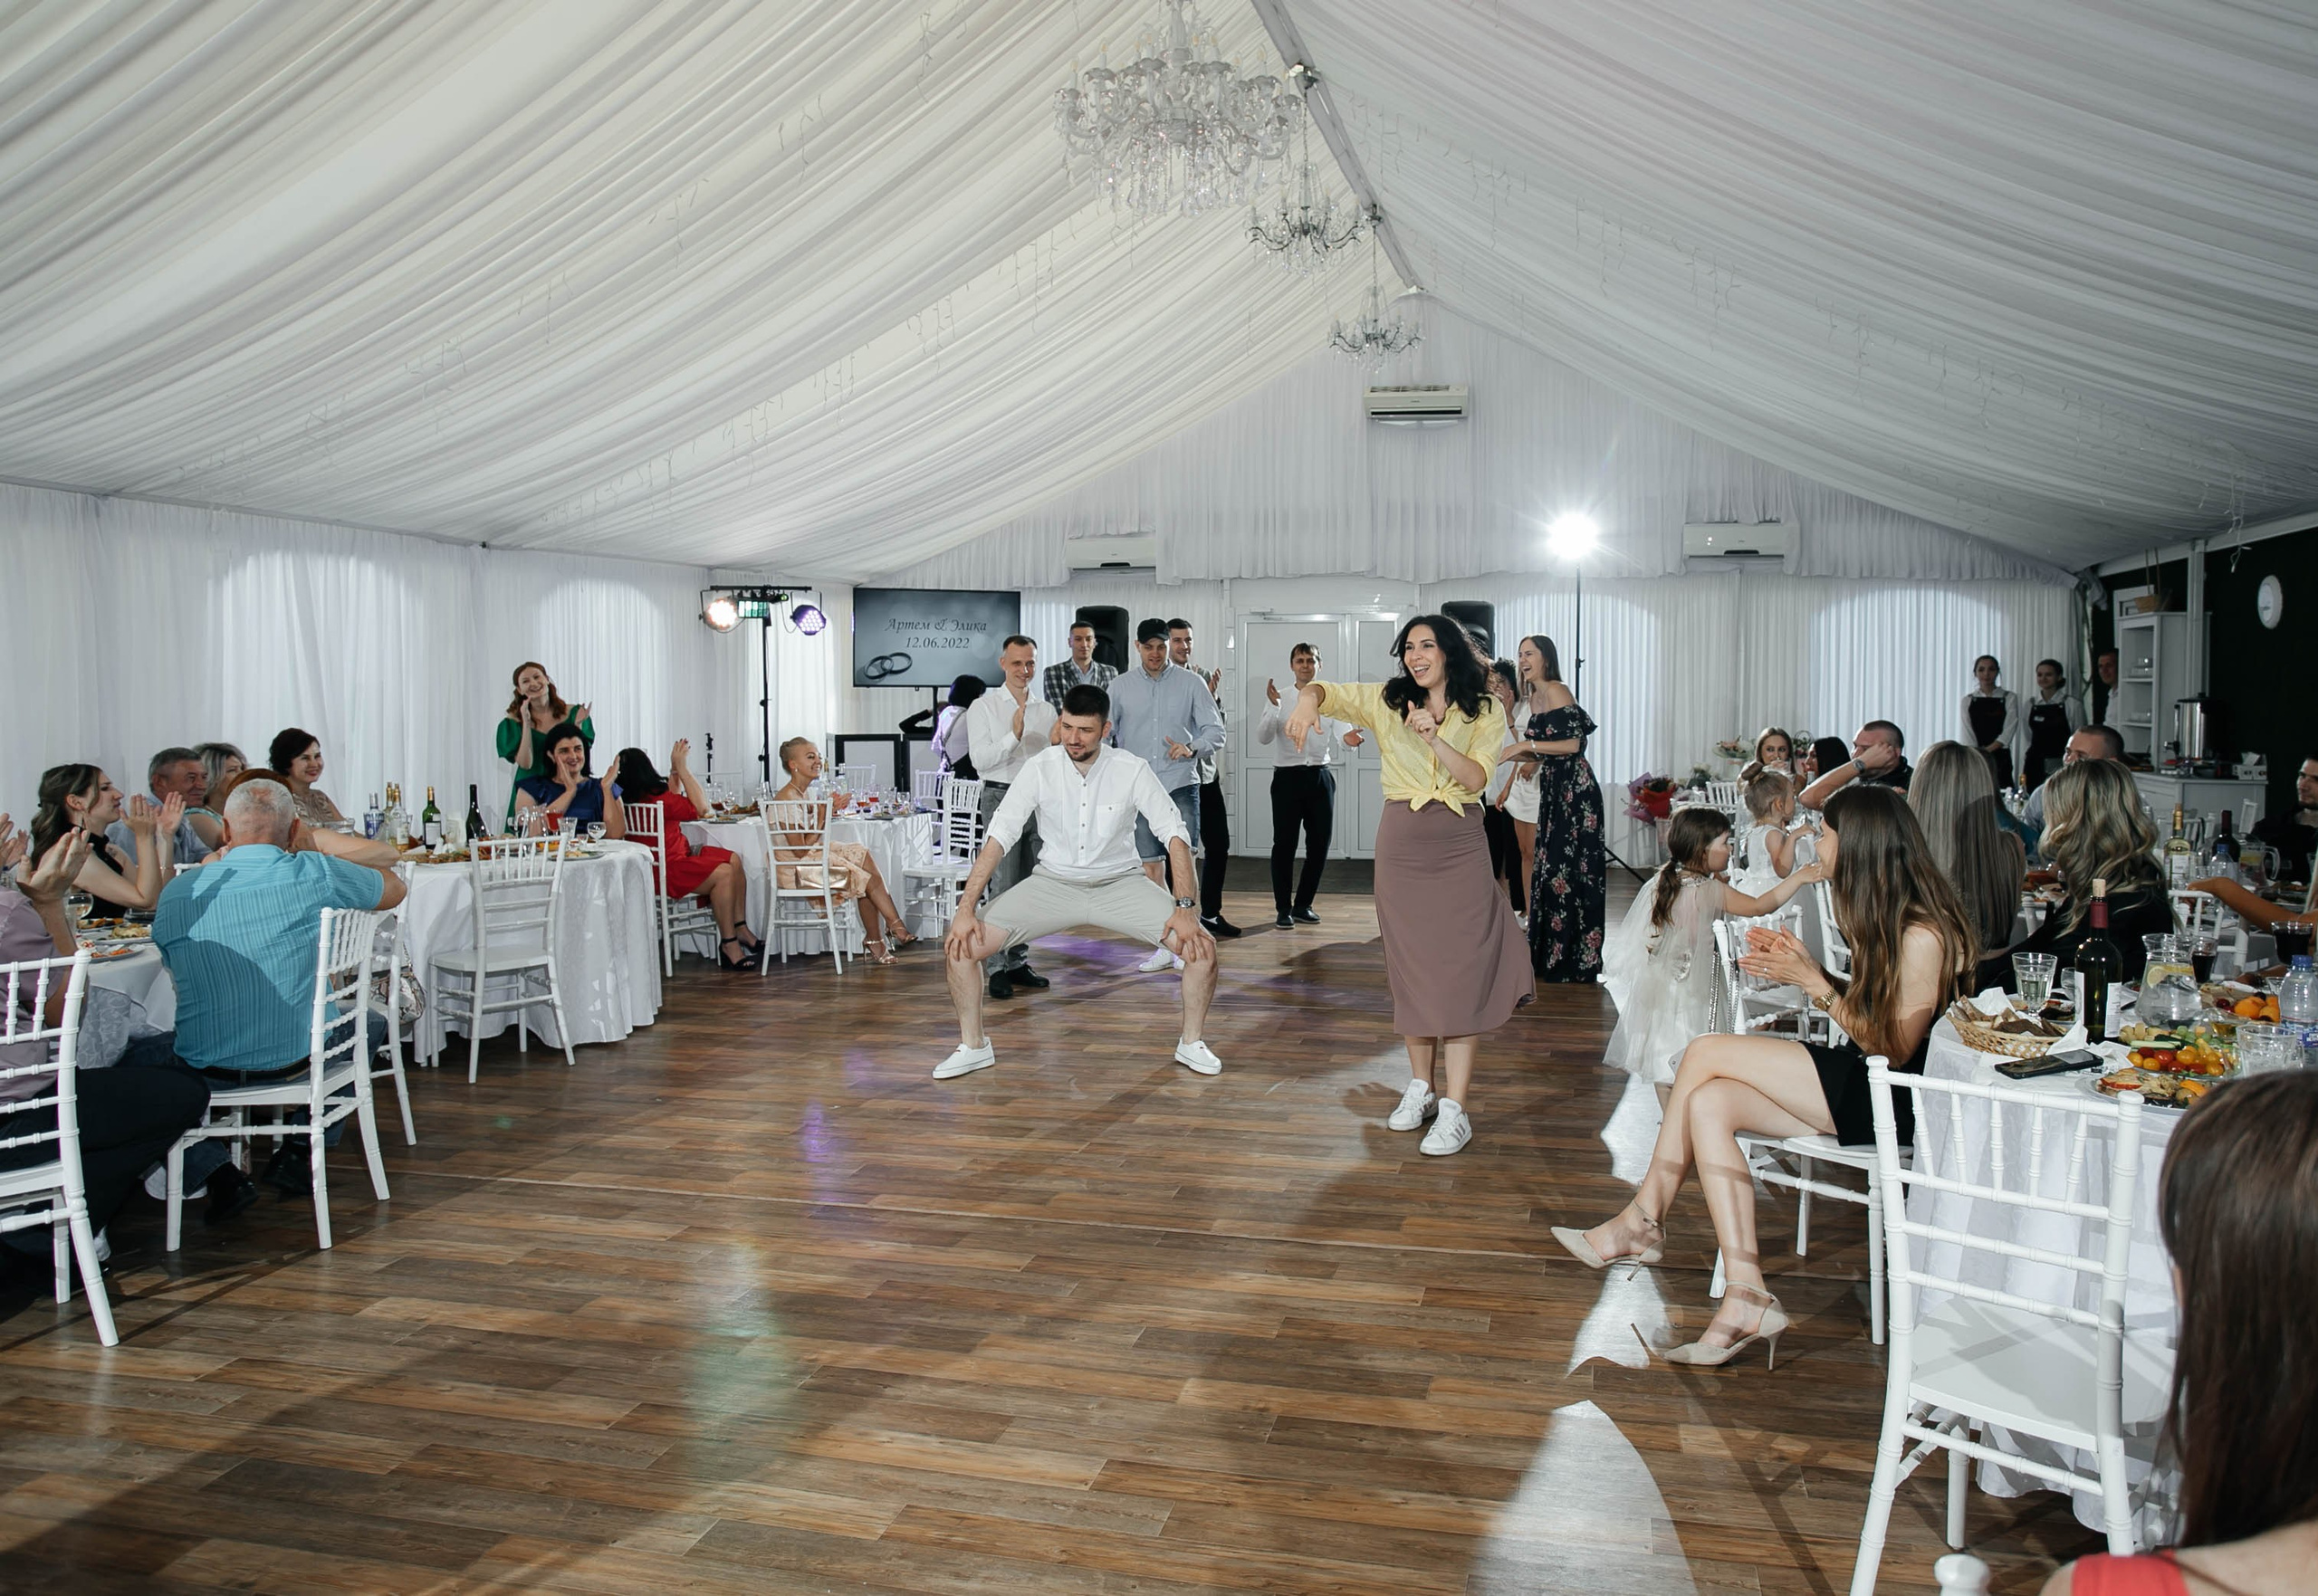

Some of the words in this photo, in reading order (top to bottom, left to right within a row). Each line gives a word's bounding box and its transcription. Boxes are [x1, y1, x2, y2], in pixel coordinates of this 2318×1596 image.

[885, 618, 930, 634] Артем
[934, 618, 948, 631] &
[951, 619, 987, 633] Элика
[905, 636, 970, 649] 12.06.2022
